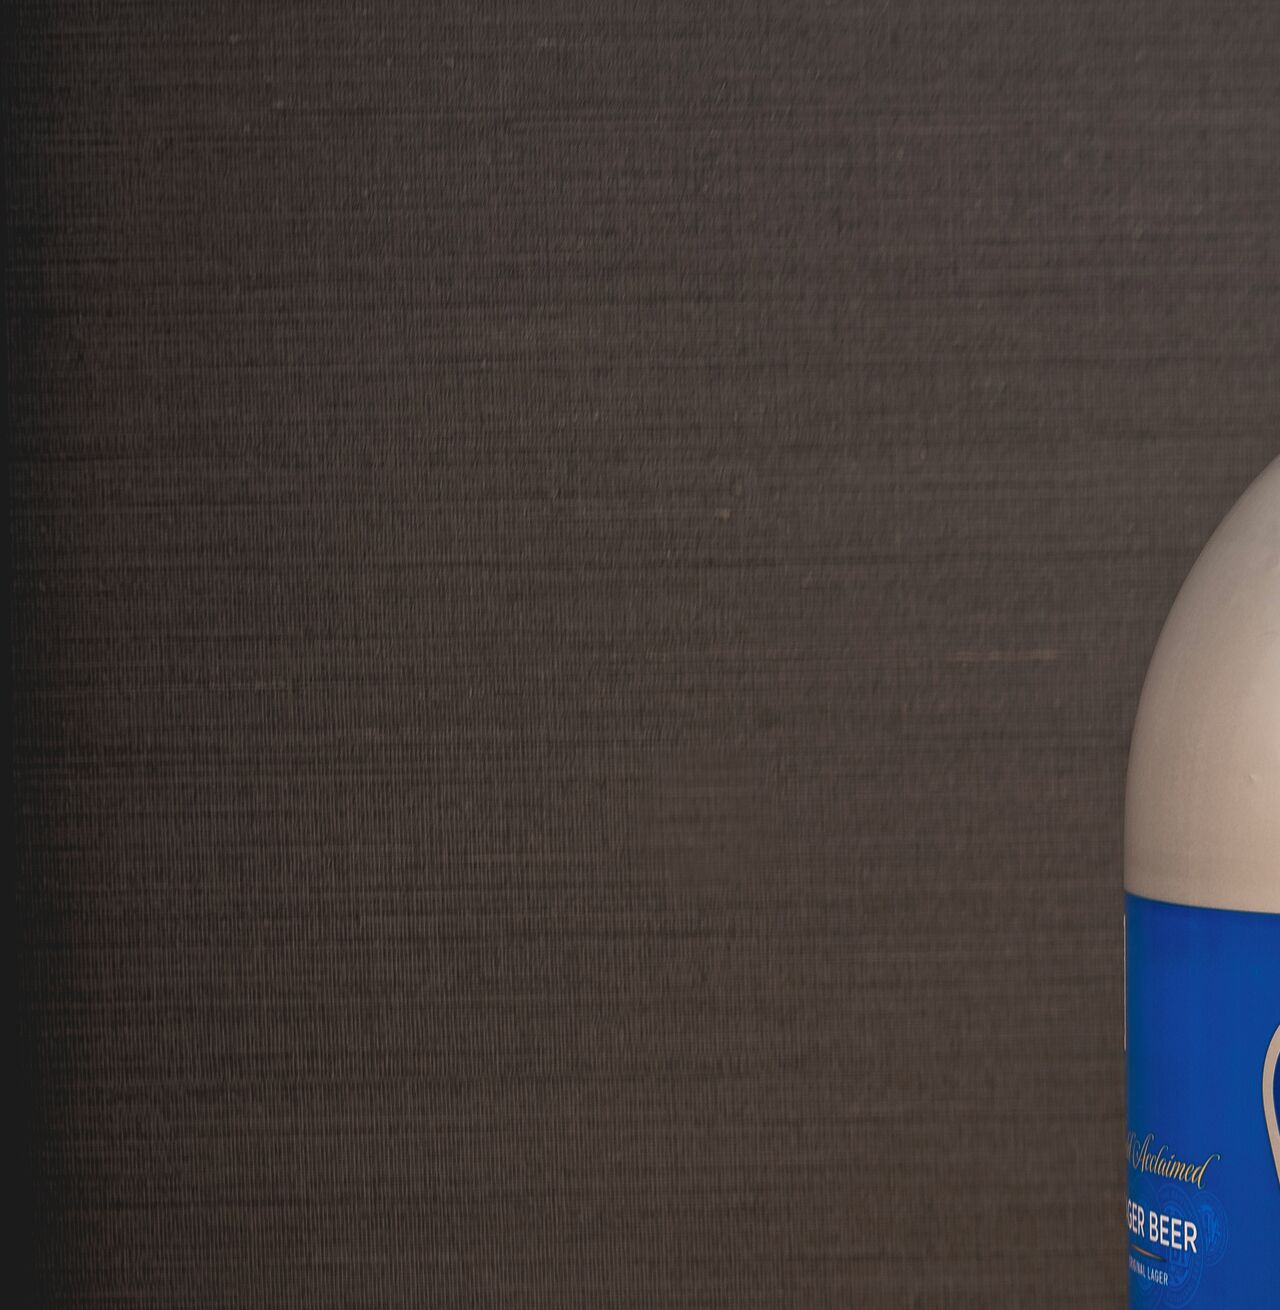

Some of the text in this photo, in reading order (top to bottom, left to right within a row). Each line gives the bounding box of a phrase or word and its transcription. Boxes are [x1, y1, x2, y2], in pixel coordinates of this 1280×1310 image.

[1132, 1131, 1221, 1190] Acclaimed
[1149, 1210, 1198, 1254] BEER
[1147, 1266, 1169, 1286] LAGER
